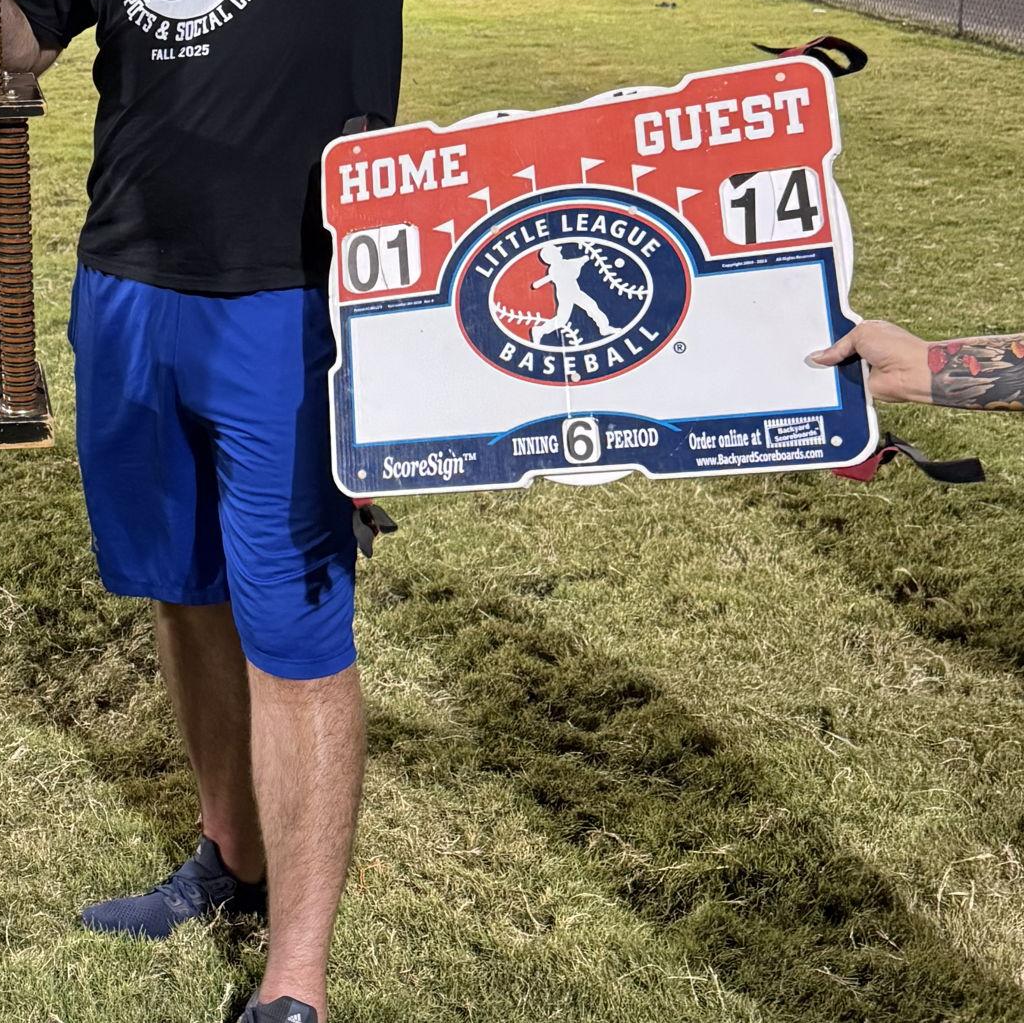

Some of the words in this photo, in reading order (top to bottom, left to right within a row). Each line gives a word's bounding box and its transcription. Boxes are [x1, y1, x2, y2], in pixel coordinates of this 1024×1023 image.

[155, 20, 170, 41] &
[175, 5, 234, 41] SOCIAL
[151, 49, 175, 61] FALL
[178, 44, 210, 58] 2025
[634, 87, 810, 157] GUEST
[339, 144, 469, 205] HOME
[730, 168, 818, 245] 14
[348, 229, 410, 292] 01
[475, 218, 550, 278] LITTLE
[561, 213, 661, 258] LEAGUE
[499, 325, 660, 375] BASEBALL
[512, 435, 559, 456] INNING
[566, 420, 594, 461] 6
[605, 427, 659, 450] PERIOD
[689, 431, 716, 450] Order
[718, 429, 749, 448] online
[751, 429, 762, 446] at
[777, 423, 810, 435] Backyard
[696, 448, 823, 467] www.BackyardScoreboards.com
